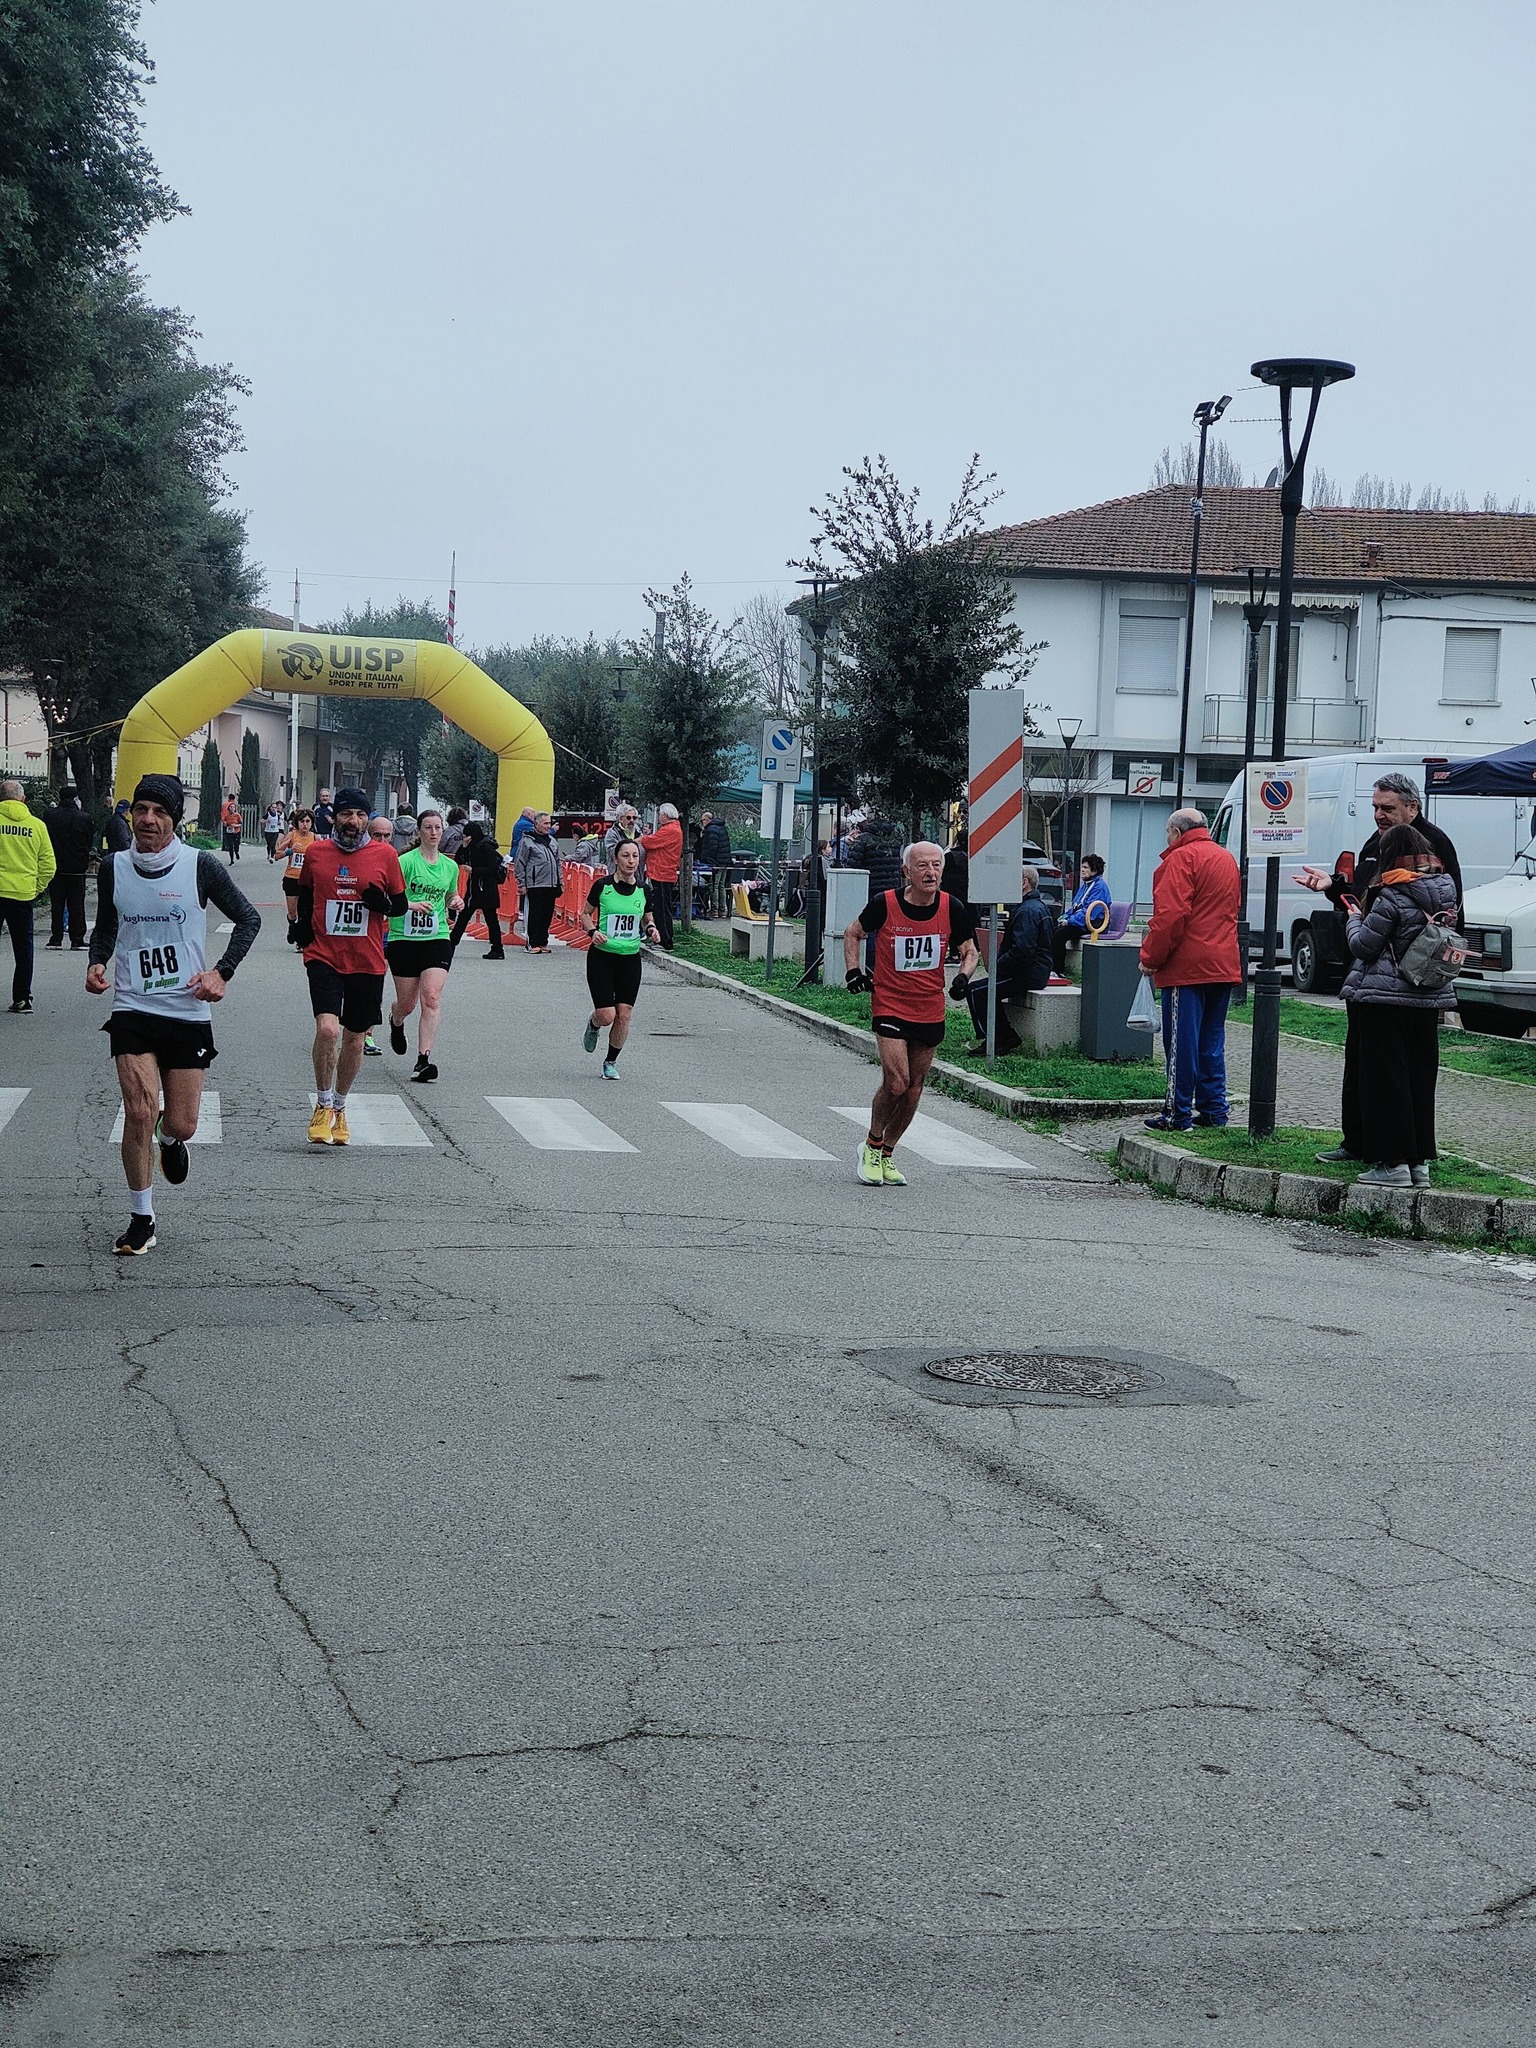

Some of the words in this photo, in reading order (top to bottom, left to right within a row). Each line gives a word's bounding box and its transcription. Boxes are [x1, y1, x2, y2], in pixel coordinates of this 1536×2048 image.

[329, 644, 404, 672] UISP
[328, 671, 362, 680] UNIONE
[365, 673, 404, 682] ITALIANA
[328, 679, 355, 688] SPORT
[358, 681, 373, 689] PER
[377, 682, 399, 690] TUTTI
[766, 758, 775, 769] P
[0, 824, 33, 838] IUDICE
[335, 901, 363, 924] 756
[411, 911, 433, 928] 636
[614, 915, 635, 931] 738
[904, 936, 934, 960] 674
[139, 945, 179, 979] 648
